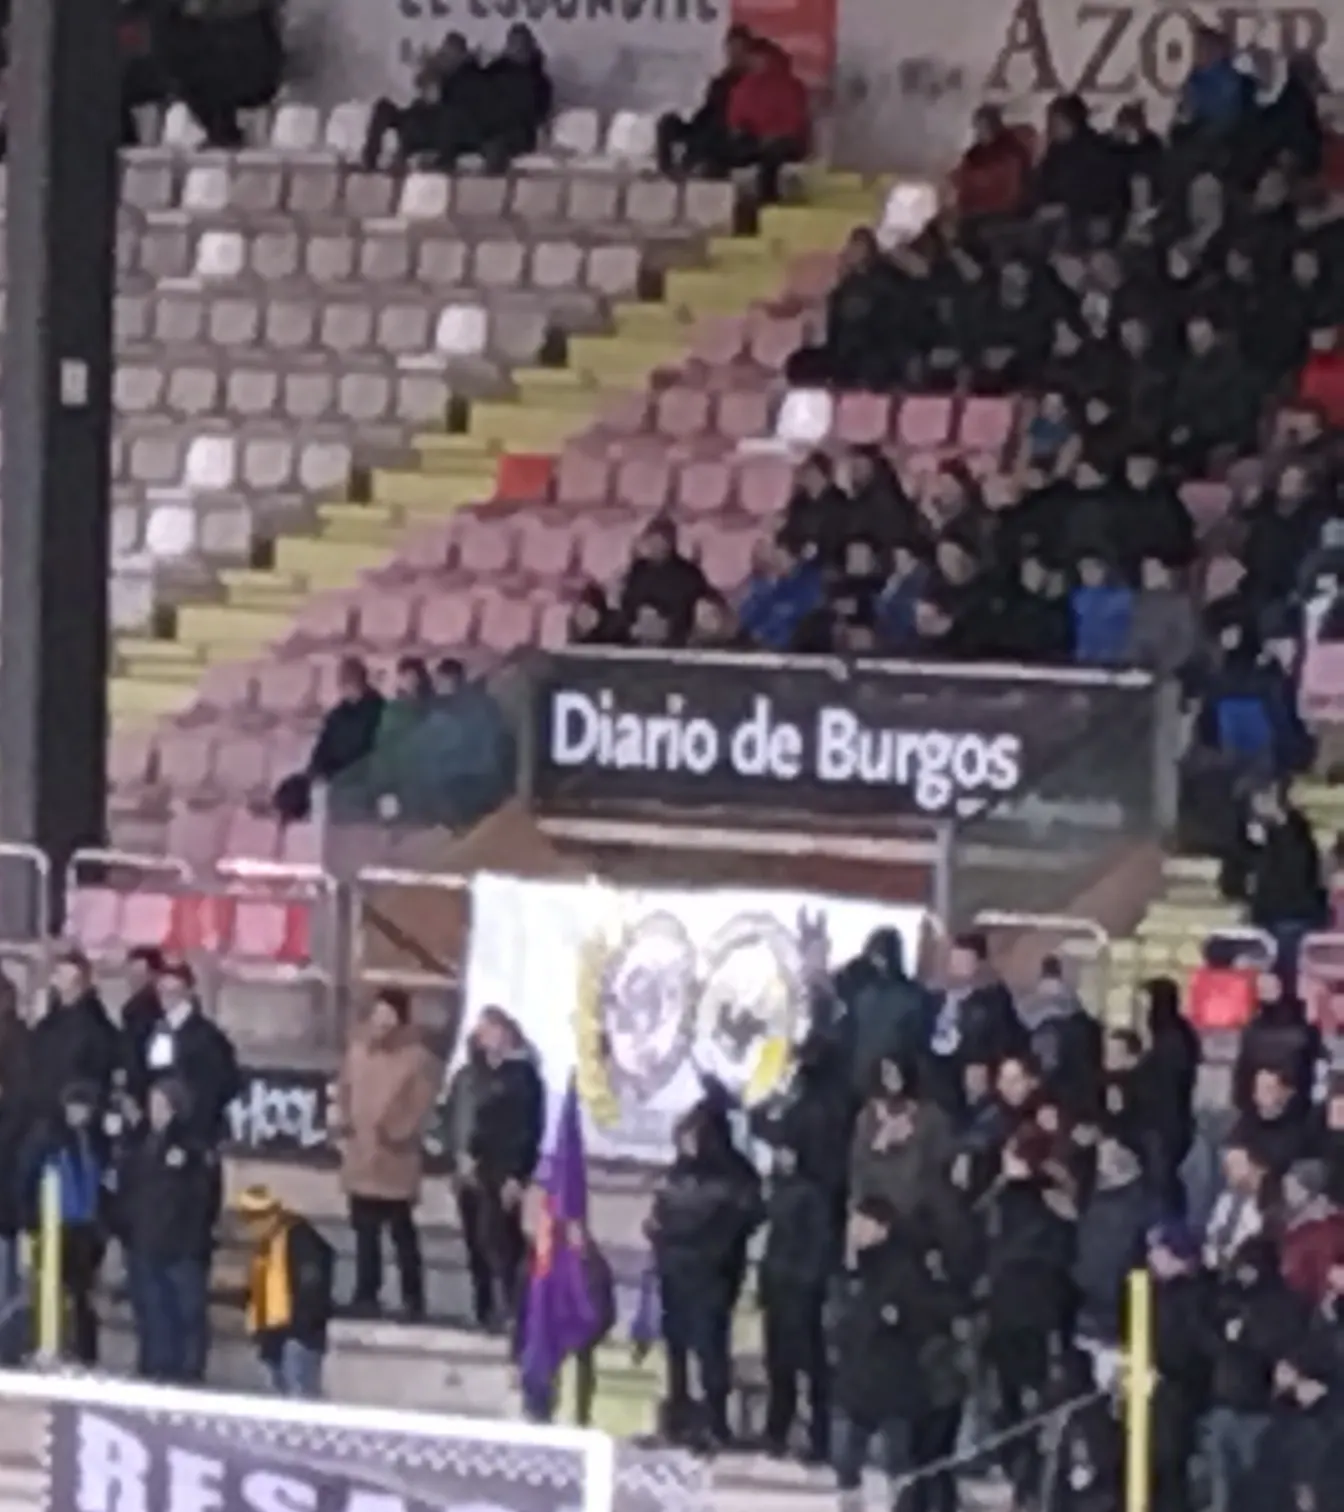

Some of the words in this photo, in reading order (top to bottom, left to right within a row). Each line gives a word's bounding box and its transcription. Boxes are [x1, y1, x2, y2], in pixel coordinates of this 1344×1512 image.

[550, 688, 719, 774] Diario
[730, 693, 803, 781] de
[816, 706, 1022, 811] Burgos
